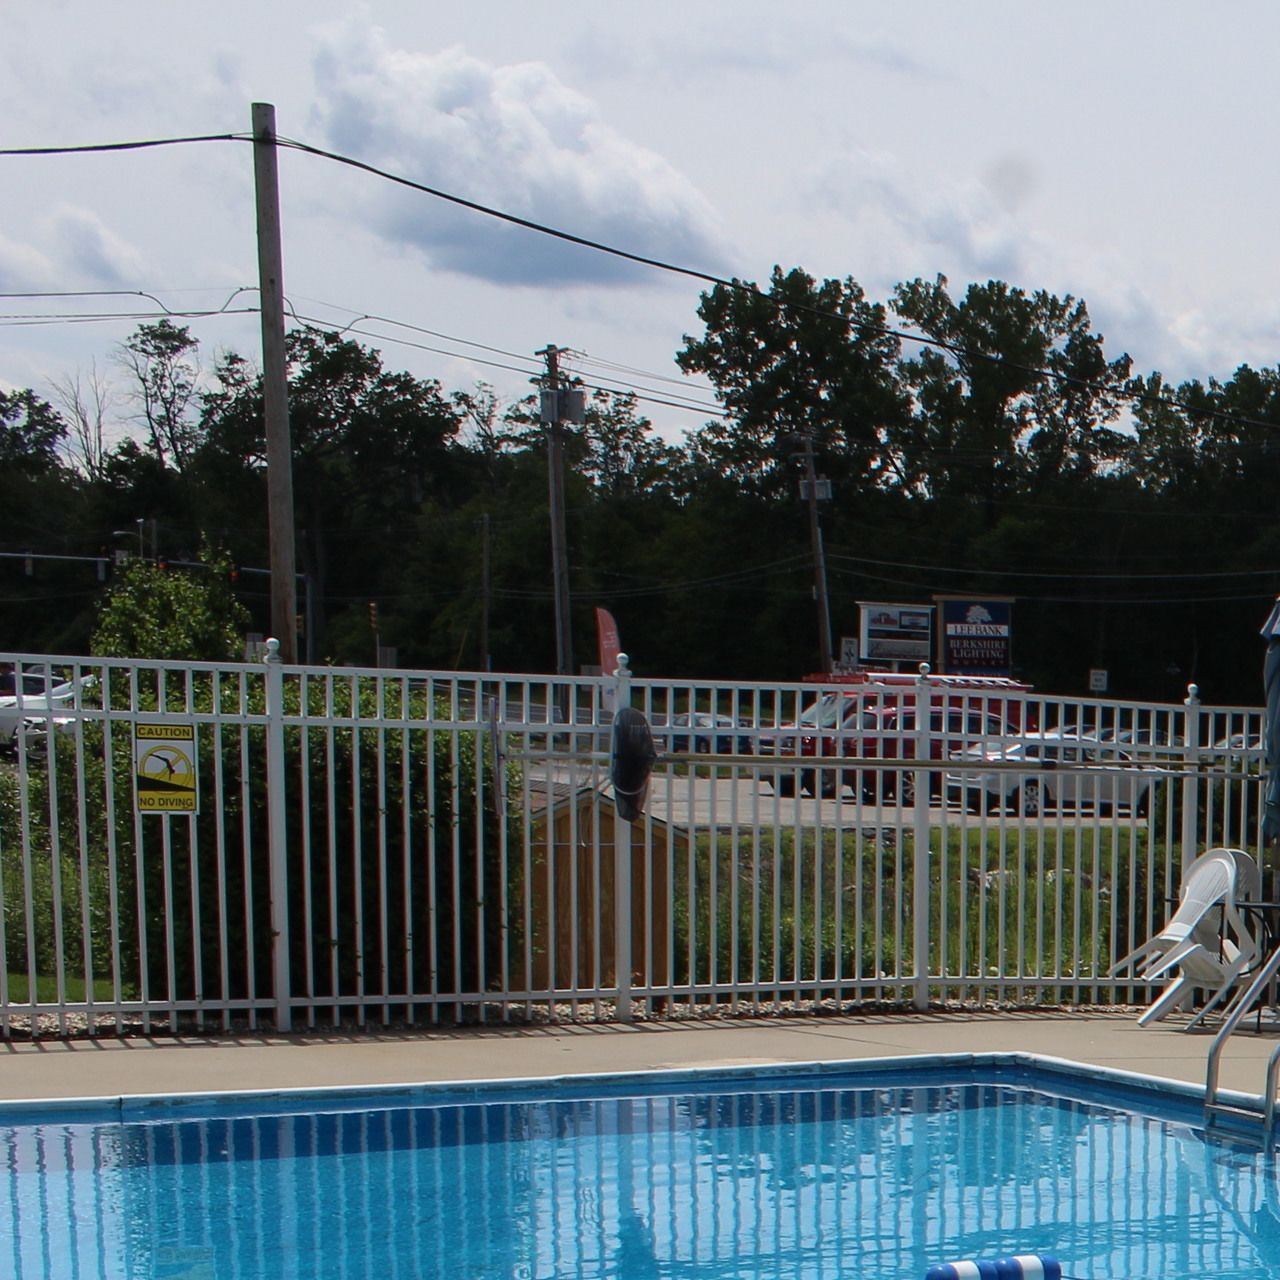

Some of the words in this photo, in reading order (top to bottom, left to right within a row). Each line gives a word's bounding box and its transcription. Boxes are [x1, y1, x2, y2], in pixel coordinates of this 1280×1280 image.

[954, 625, 975, 634] LEE
[976, 625, 1004, 635] BANK
[949, 639, 1007, 649] BERKSHIRE
[953, 649, 1004, 659] LIGHTING
[138, 727, 190, 737] CAUTION
[140, 798, 155, 806] NO
[158, 798, 193, 807] DIVING
